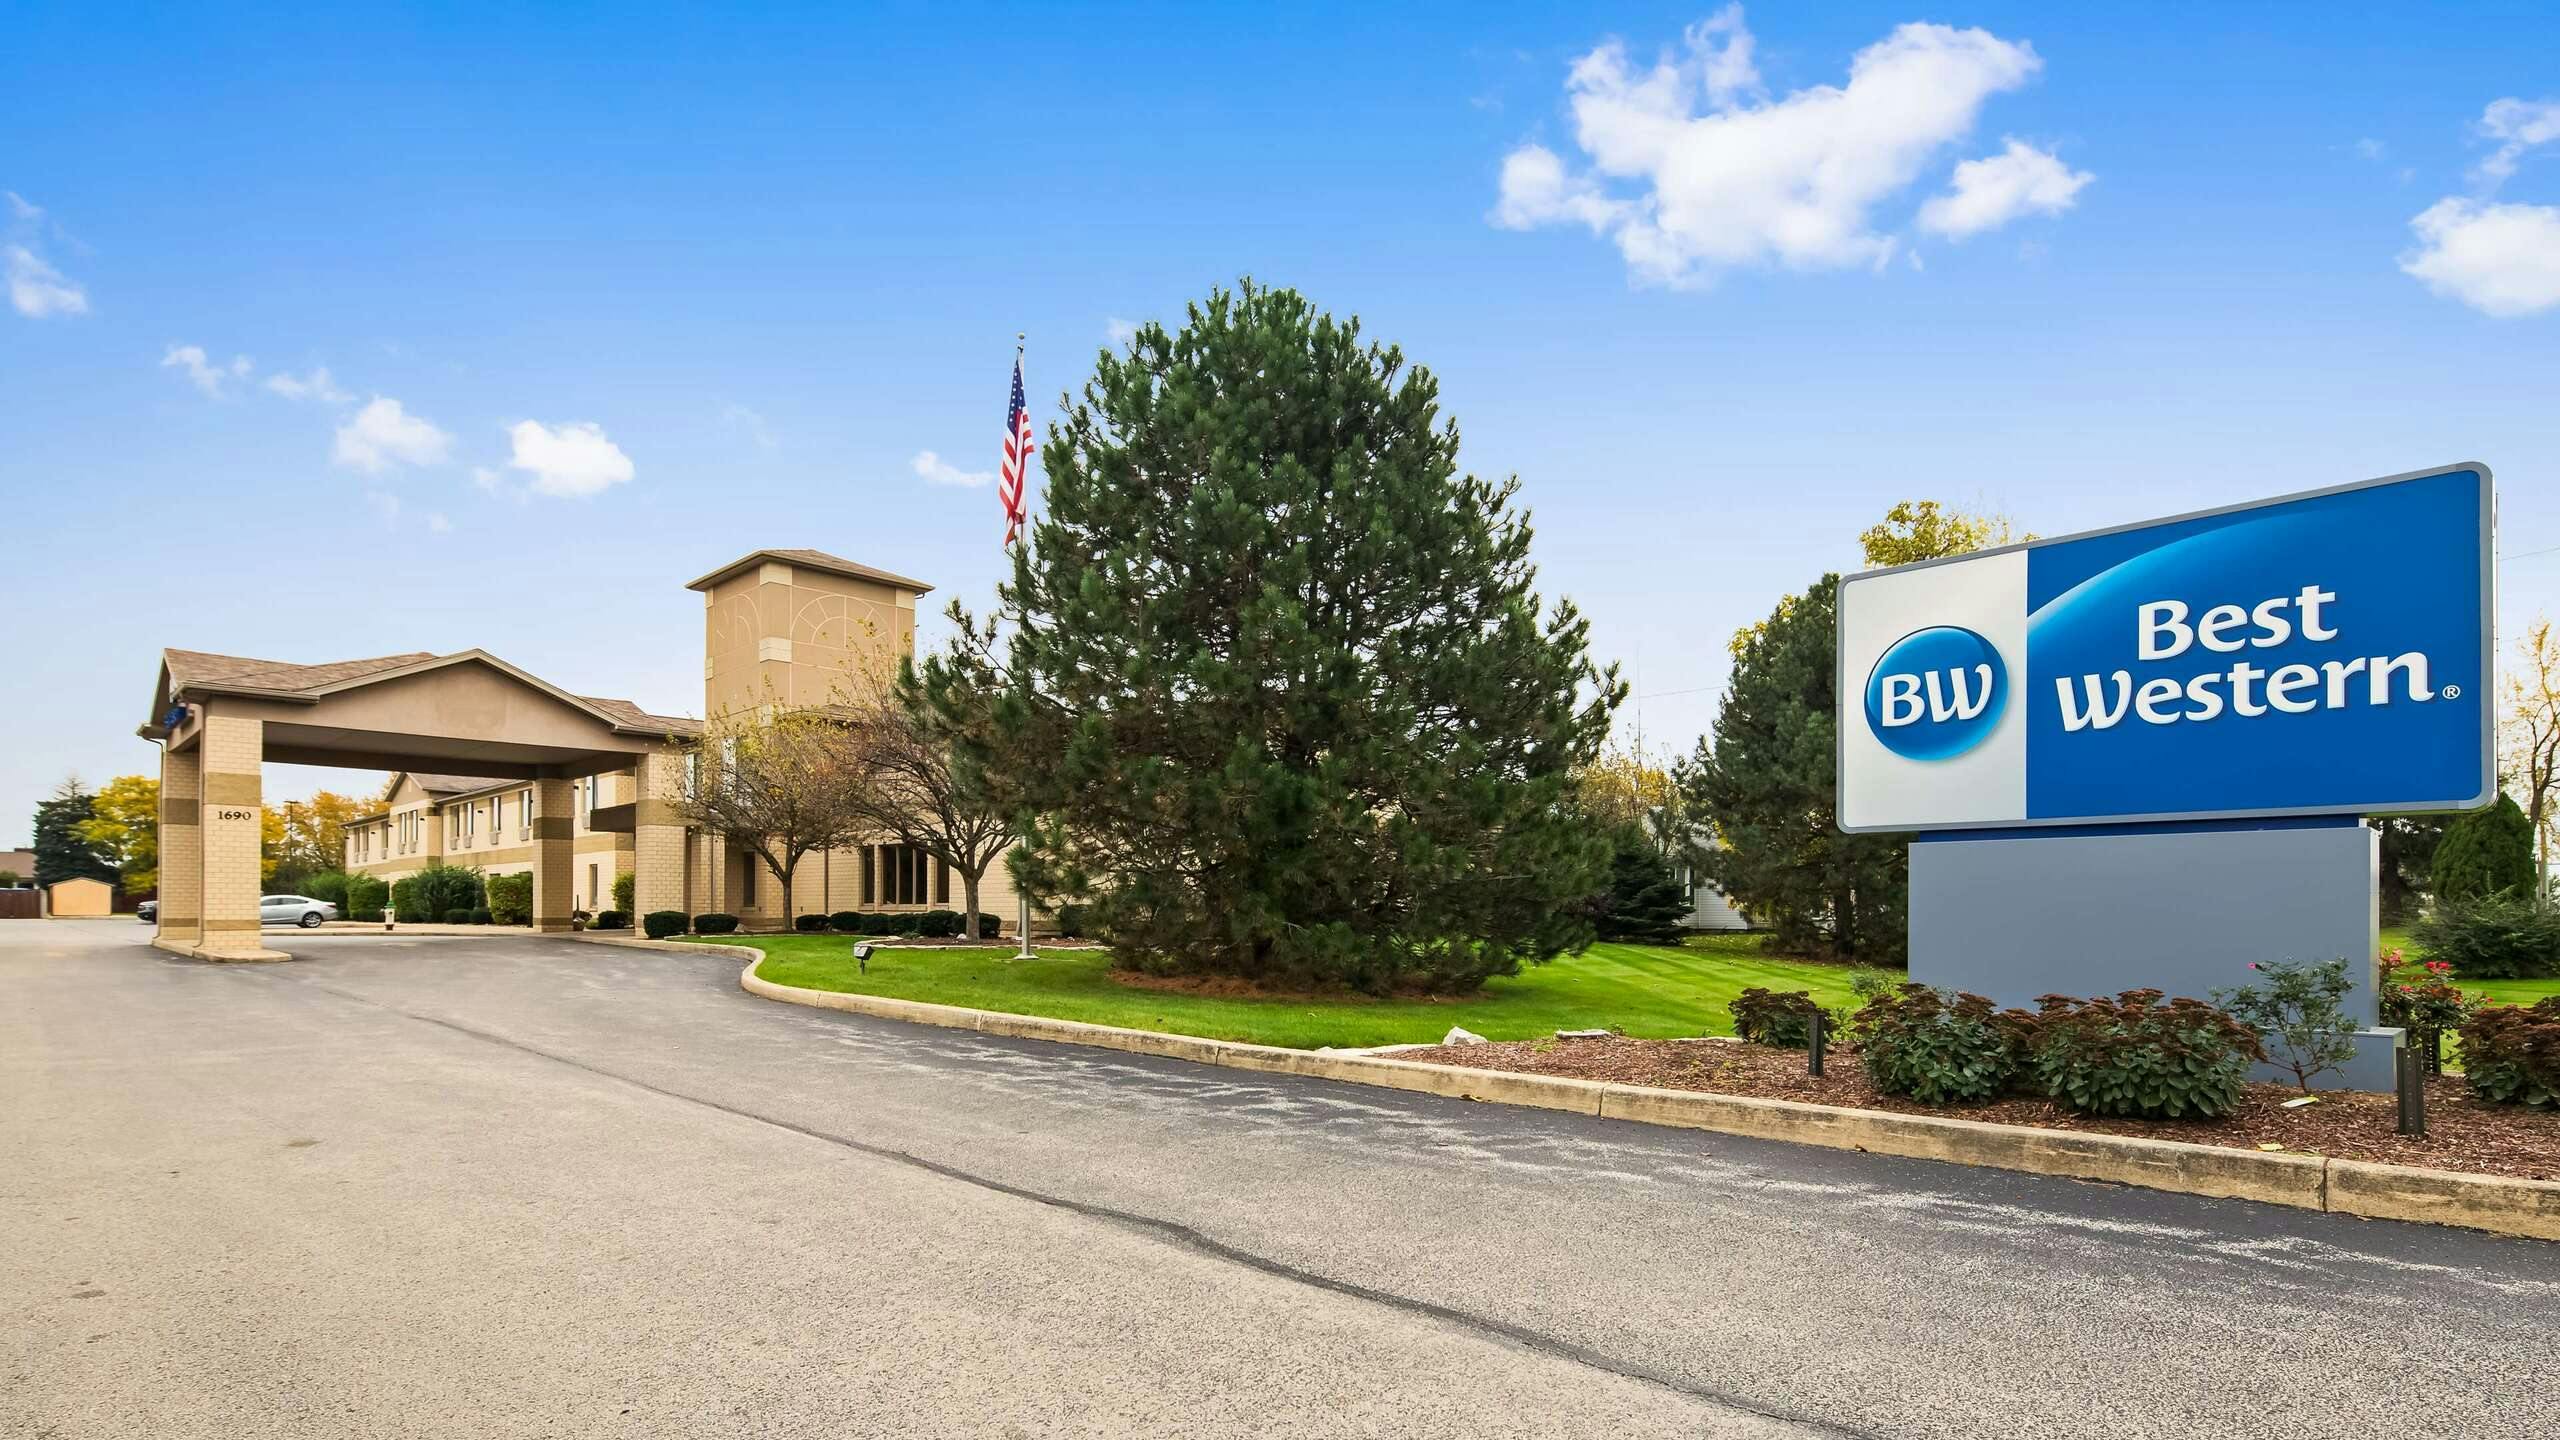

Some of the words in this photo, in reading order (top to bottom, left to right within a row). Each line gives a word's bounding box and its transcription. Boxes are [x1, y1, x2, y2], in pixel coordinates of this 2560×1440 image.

[2138, 585, 2339, 661] Best
[1881, 663, 1993, 727] BW
[2055, 651, 2435, 732] Western
[217, 810, 252, 821] 1690
